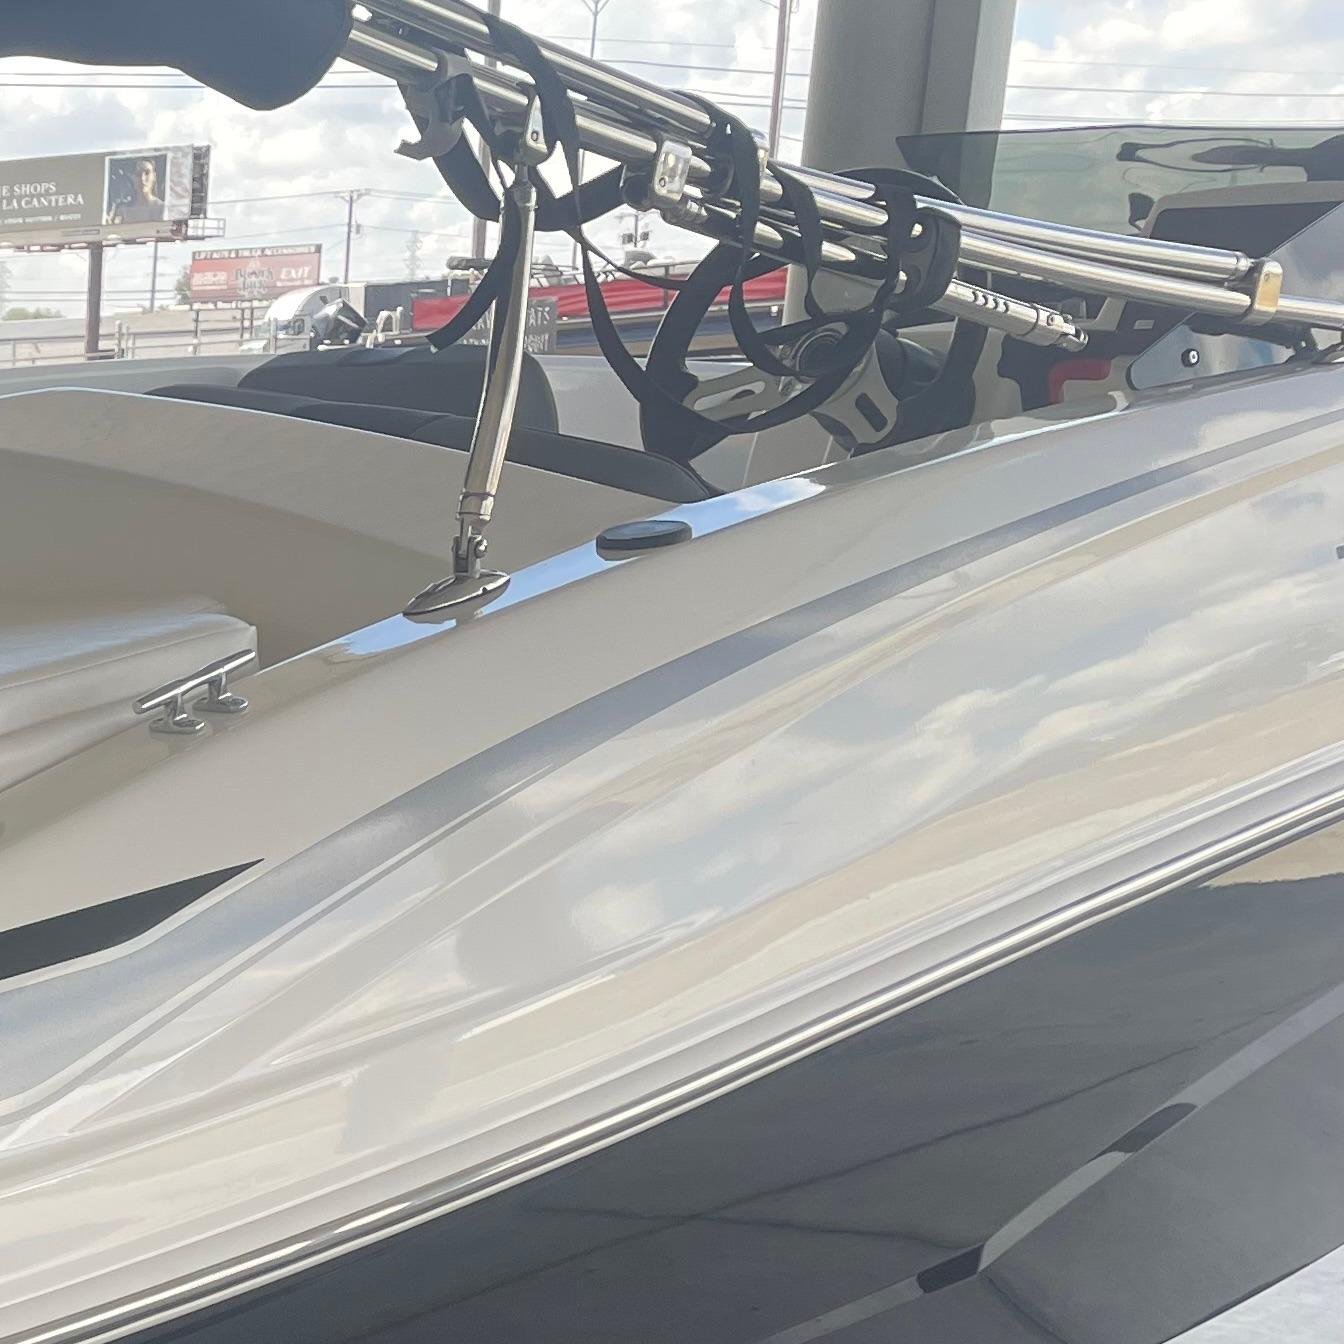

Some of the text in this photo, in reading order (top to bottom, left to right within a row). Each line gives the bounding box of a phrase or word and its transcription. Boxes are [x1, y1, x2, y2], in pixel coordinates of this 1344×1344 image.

[13, 182, 56, 196] SHOPS
[2, 198, 19, 210] LA
[21, 194, 84, 209] CANTERA
[279, 266, 313, 280] EXIT
